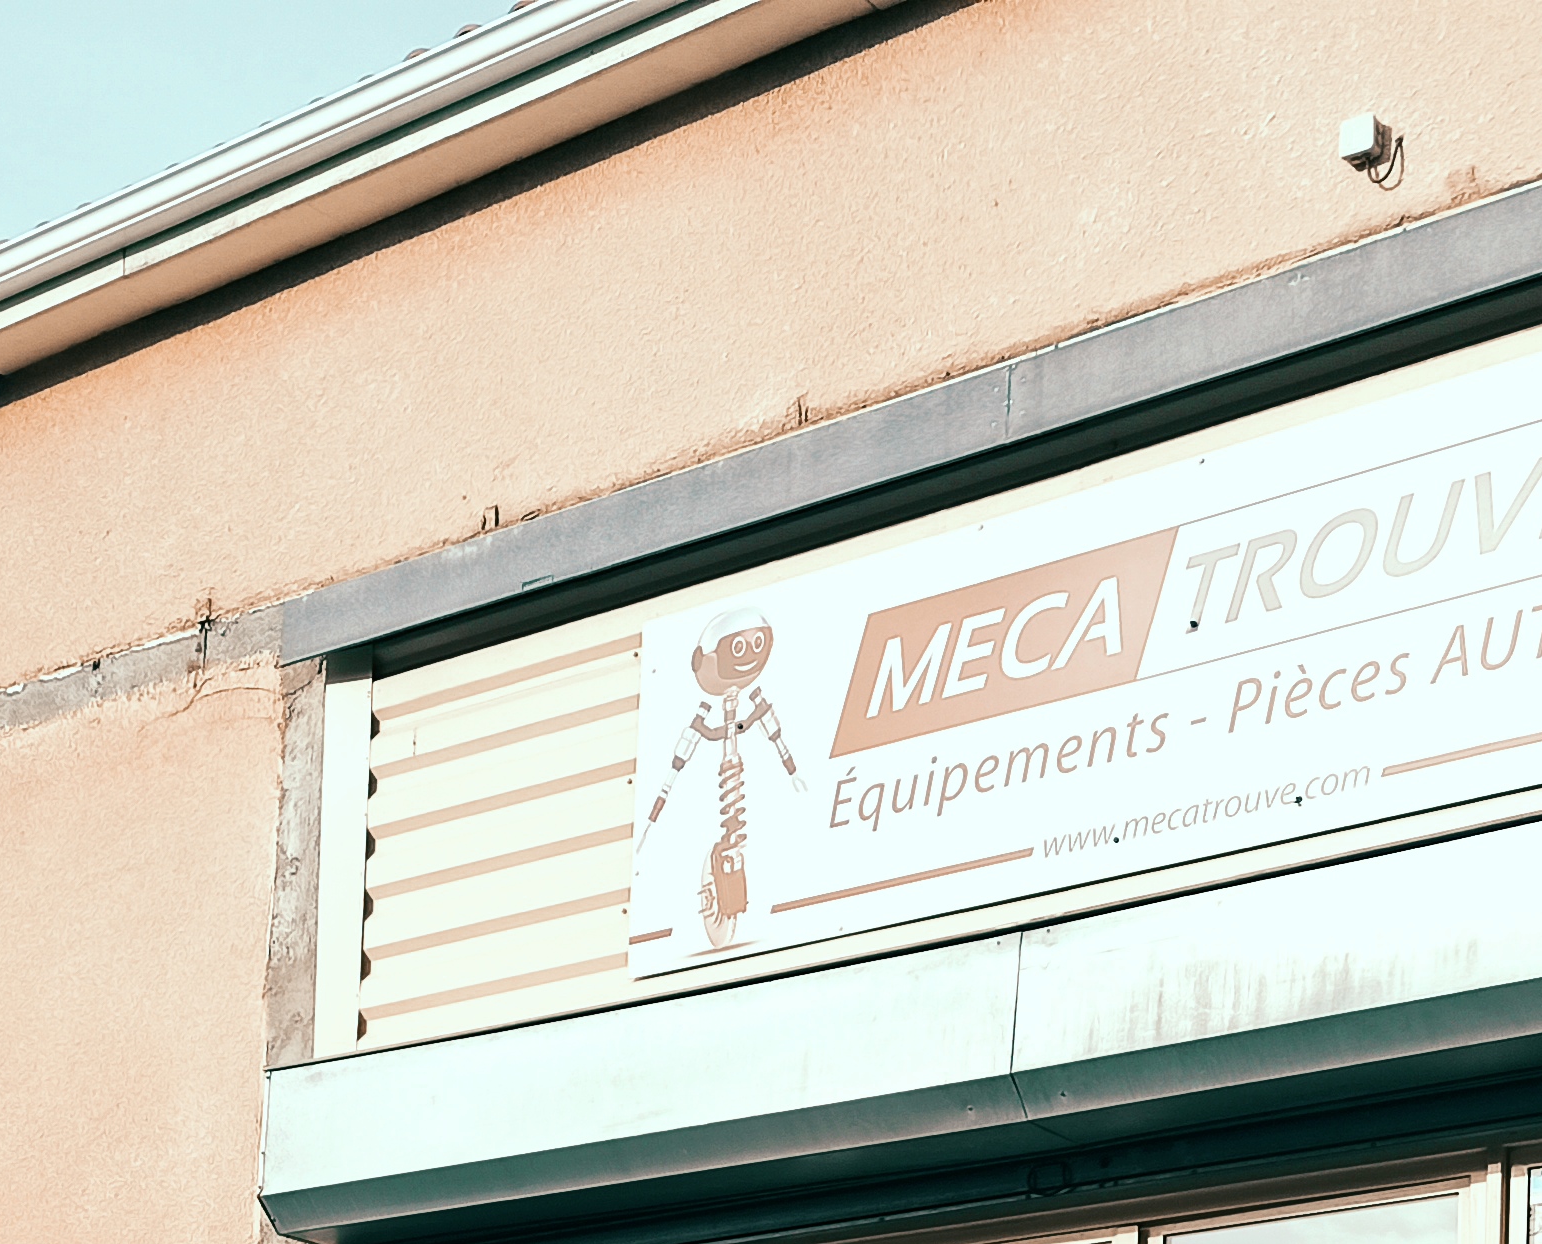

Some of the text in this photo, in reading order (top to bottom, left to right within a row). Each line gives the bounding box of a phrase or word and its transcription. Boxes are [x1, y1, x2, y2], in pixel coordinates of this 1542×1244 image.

[865, 574, 1124, 720] MECA
[828, 710, 1170, 832] Équipements
[1227, 651, 1410, 733] Pièces
[1043, 765, 1371, 859] www.mecatrouve.com
